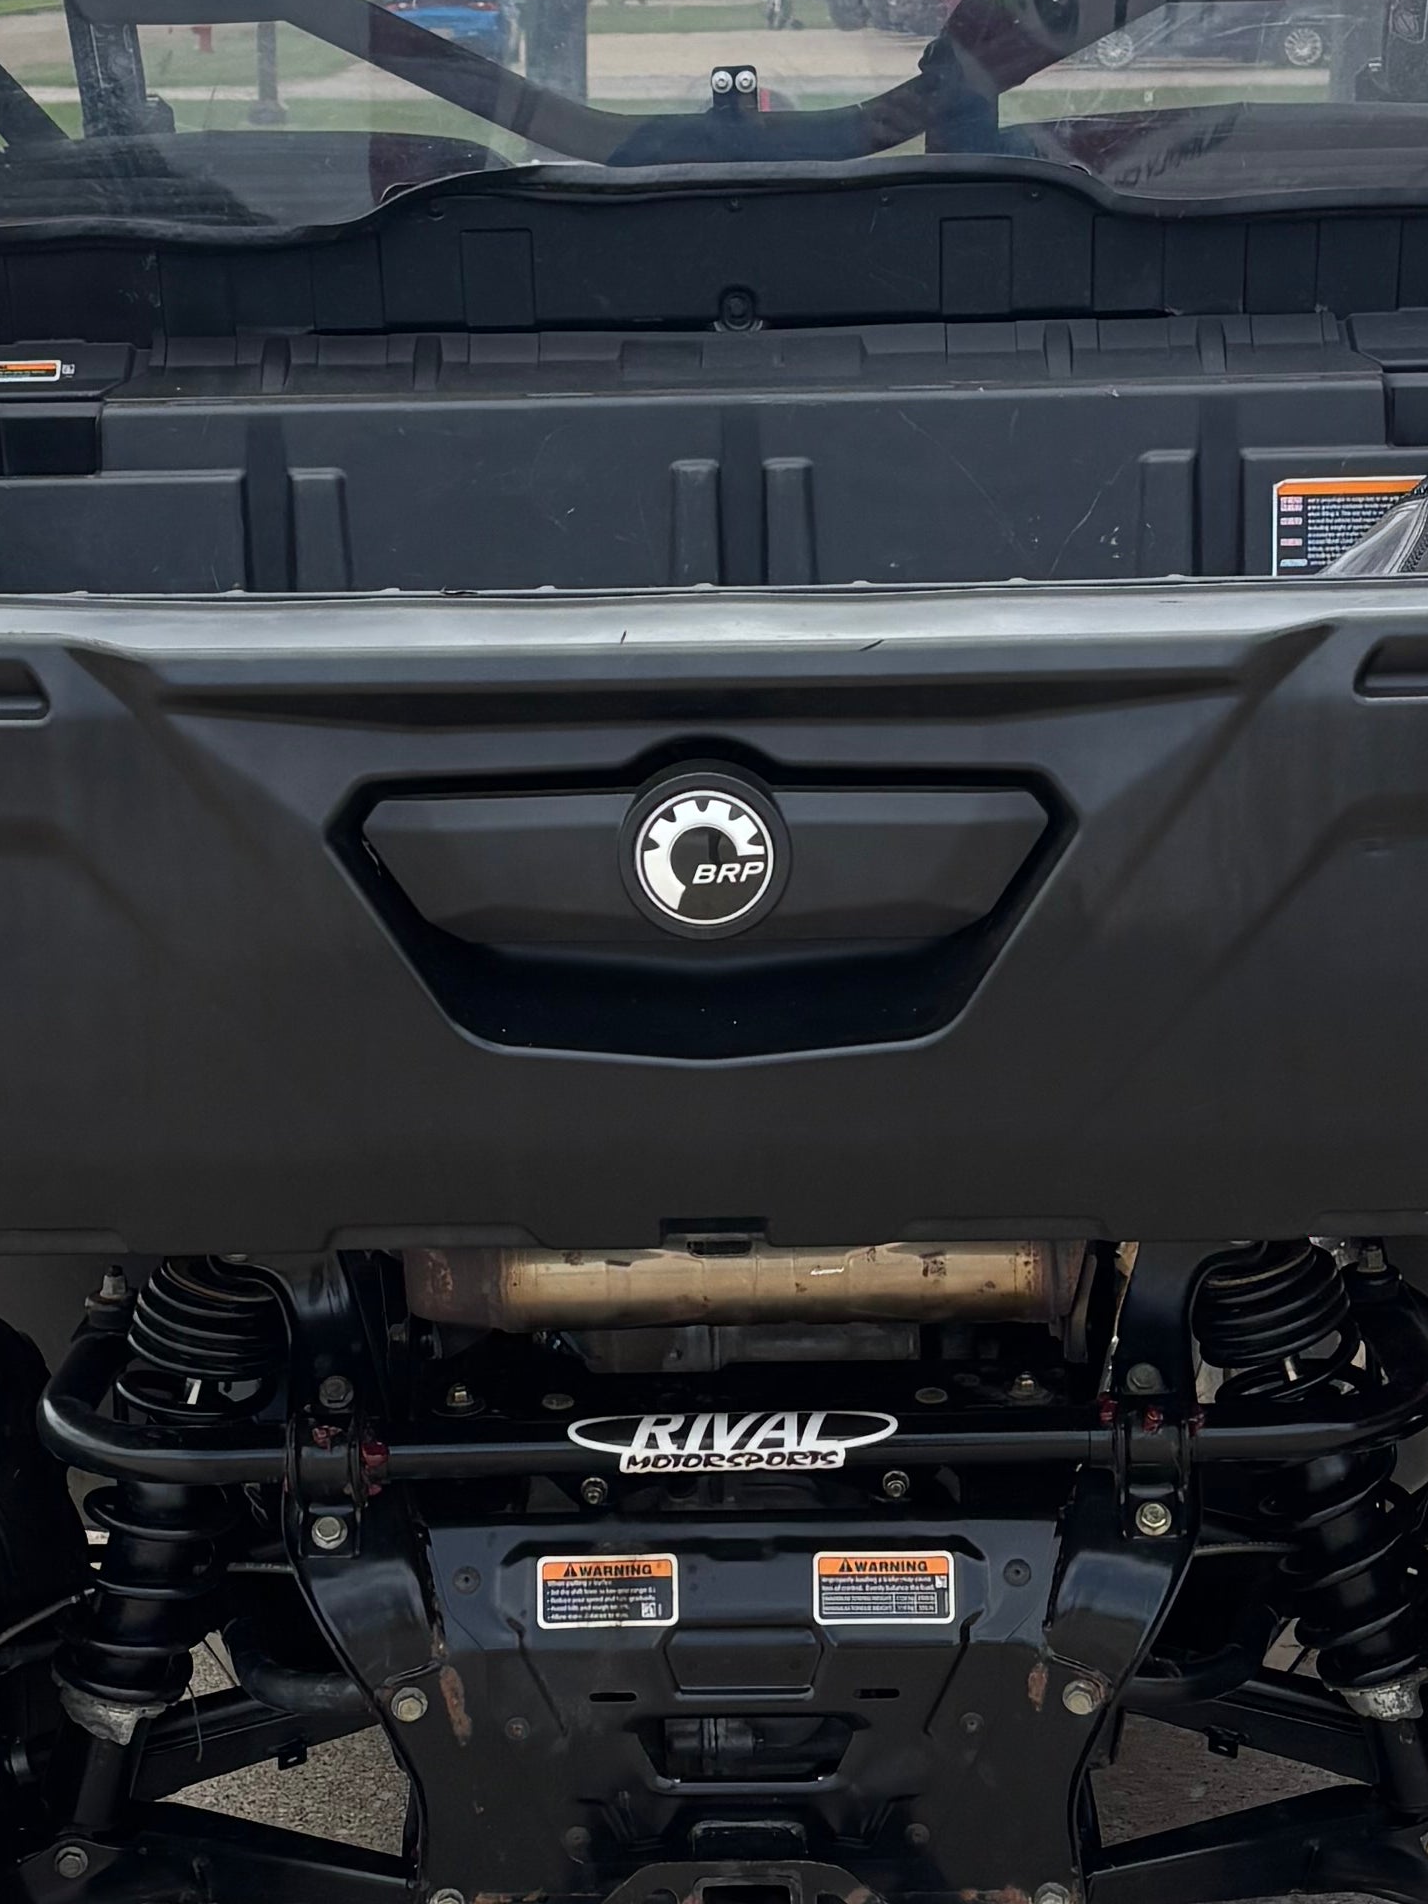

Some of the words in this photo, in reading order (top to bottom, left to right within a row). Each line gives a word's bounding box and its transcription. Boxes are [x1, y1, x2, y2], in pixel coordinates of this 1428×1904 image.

[692, 861, 765, 884] BRP
[630, 1411, 840, 1452] RIVAL
[625, 1450, 840, 1471] MOTORSPORTS
[579, 1564, 652, 1577] WARNING
[854, 1560, 928, 1573] WARNING
